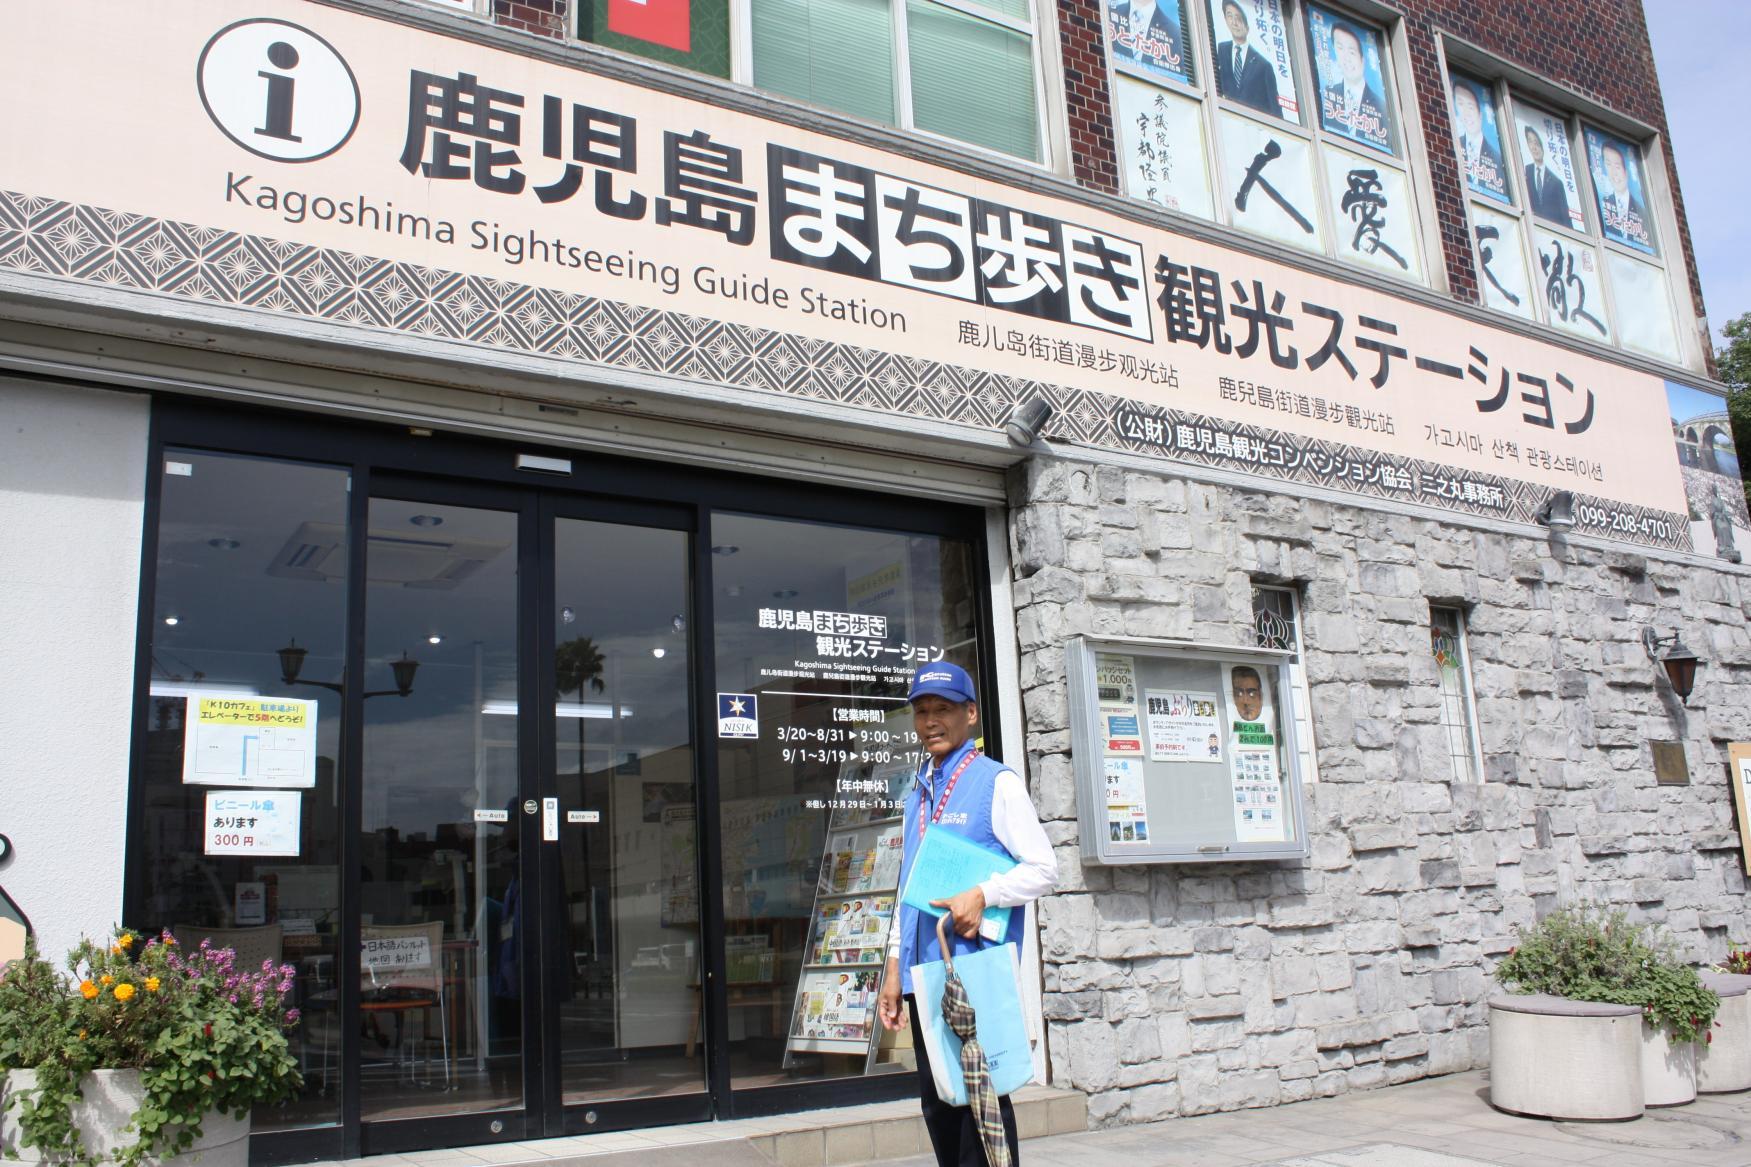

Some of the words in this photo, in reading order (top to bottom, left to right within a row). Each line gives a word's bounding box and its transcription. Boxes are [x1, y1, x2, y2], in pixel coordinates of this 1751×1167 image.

[1235, 139, 1314, 234] 人
[226, 171, 456, 244] Kagoshima
[471, 220, 681, 294] Sightseeing
[694, 265, 789, 309] Guide
[801, 286, 907, 334] Station
[958, 319, 1179, 389] 鹿儿岛街道漫步观光站
[1424, 423, 1483, 455] 가고시마
[1492, 439, 1519, 463] 산책
[1526, 447, 1603, 482] 관광스테이션
[1580, 505, 1672, 539] 099-208-4701
[758, 608, 887, 638] 鹿児島まち歩き
[816, 636, 944, 662] 観光ステーション
[794, 659, 832, 670] Kagoshima
[833, 662, 871, 674] Sightseeing
[872, 664, 891, 674] Guide
[892, 666, 915, 675] Station
[832, 708, 885, 723] 【営業時間】
[860, 730, 889, 743] 9:00
[861, 752, 891, 764] 9:00
[835, 779, 889, 793] 【年中無休】
[214, 799, 274, 811] ビニール傘
[213, 817, 258, 829] あります
